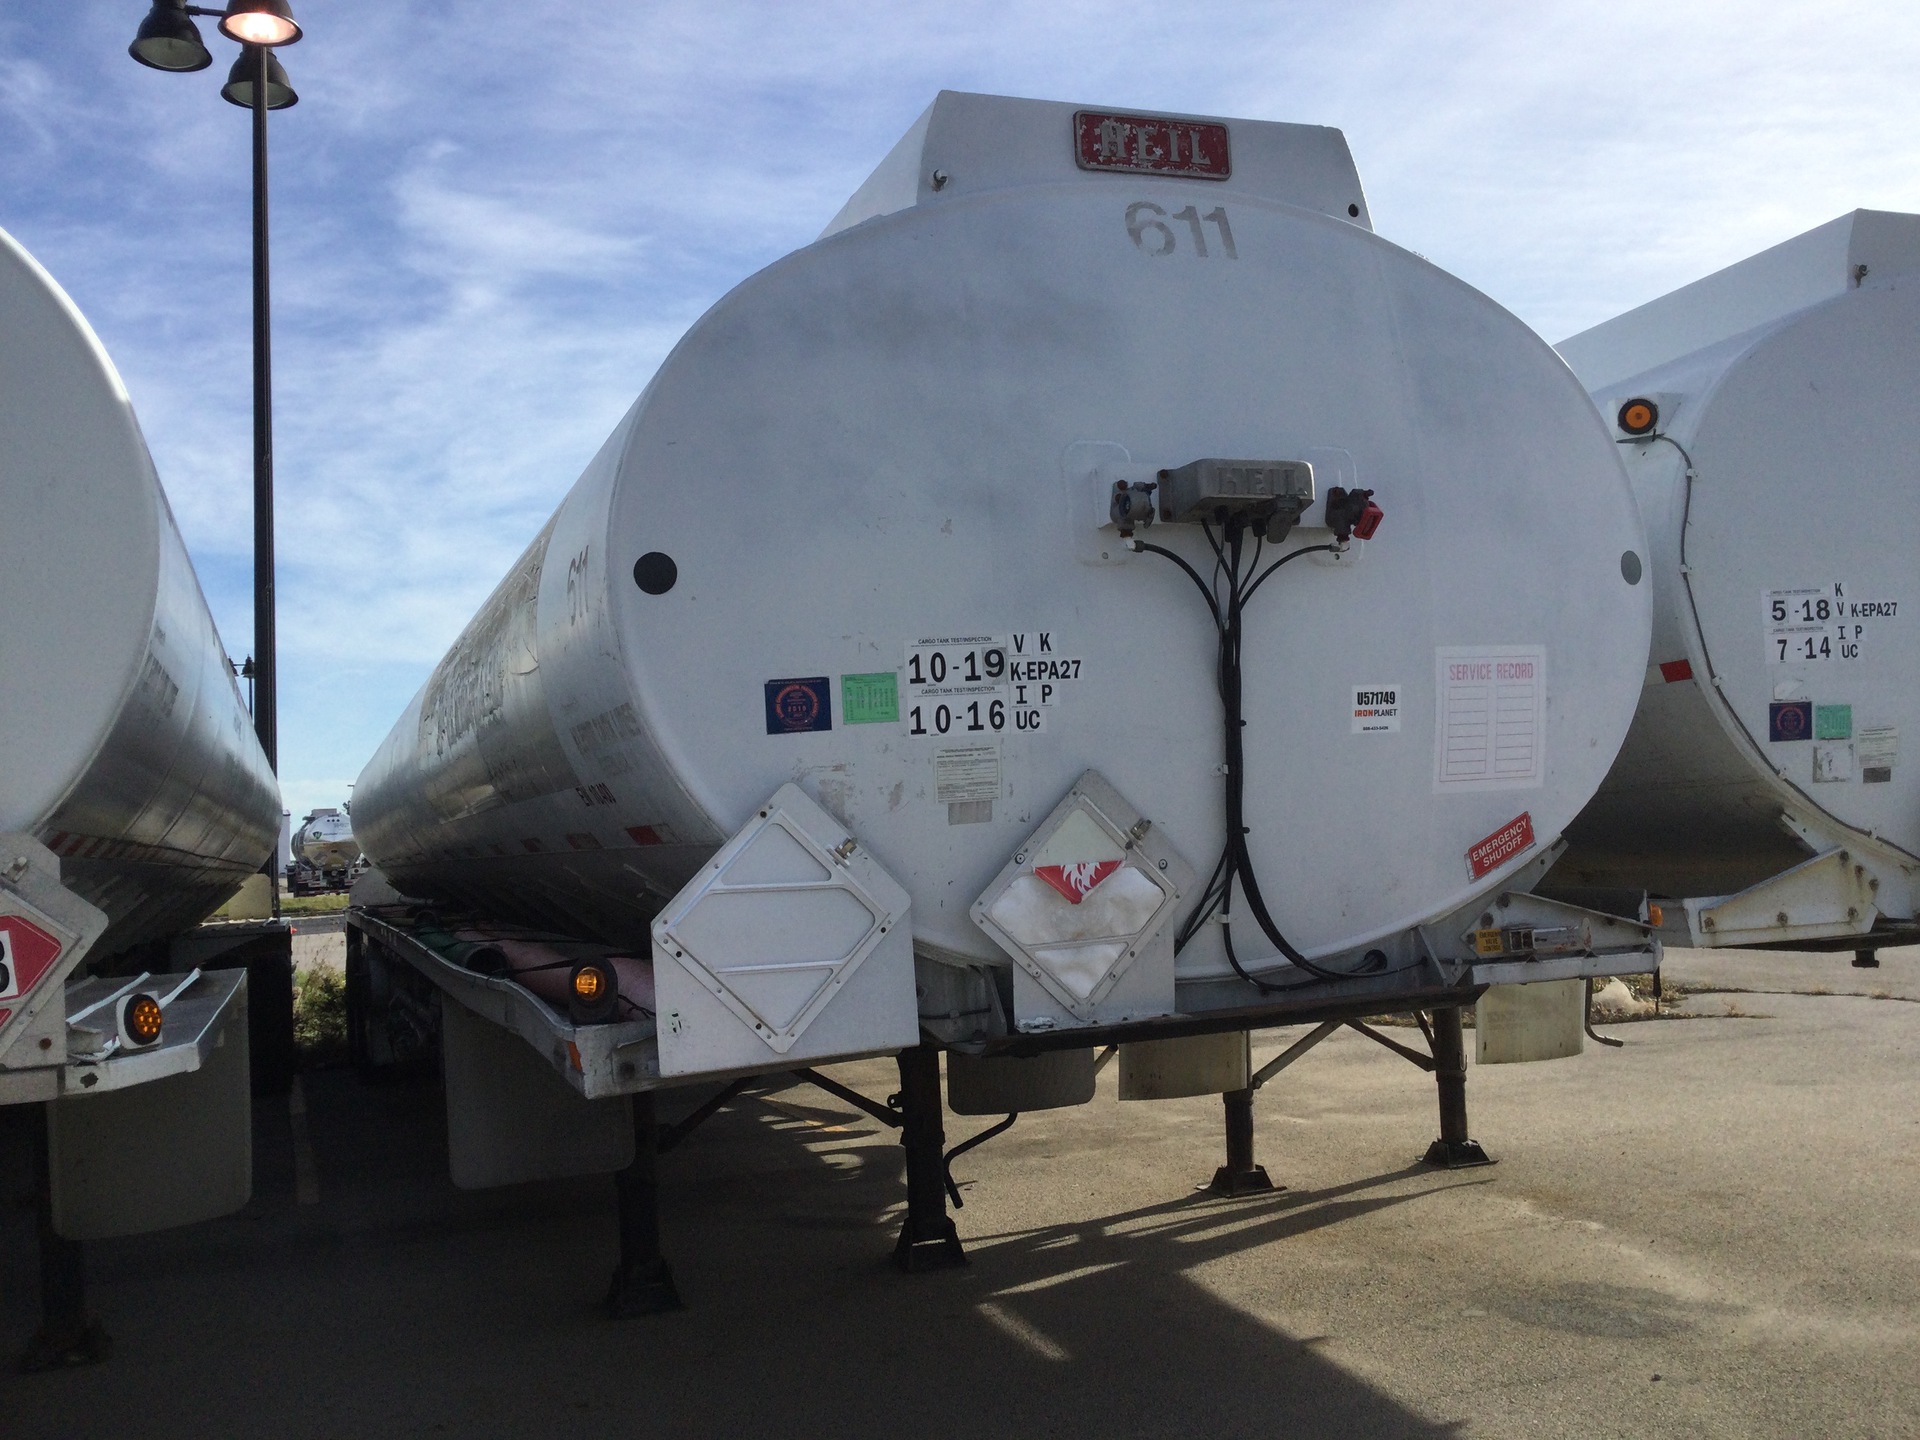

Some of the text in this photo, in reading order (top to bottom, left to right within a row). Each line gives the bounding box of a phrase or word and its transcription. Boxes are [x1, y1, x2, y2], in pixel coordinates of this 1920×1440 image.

[1099, 121, 1211, 165] HEIL
[1125, 201, 1239, 260] 611
[1834, 583, 1844, 597] K
[1836, 601, 1845, 616] V
[1850, 602, 1898, 618] K-EPA27
[1013, 632, 1052, 654] V K
[1855, 625, 1863, 640] P
[1841, 644, 1859, 659] UC
[908, 648, 1005, 685] 10-19
[1010, 660, 1082, 682] K-EPA27
[1449, 662, 1534, 681] SERVICE RECORD
[1015, 684, 1053, 705] I P
[1357, 691, 1396, 706] U571749
[909, 699, 1005, 736] 10-16
[1016, 709, 1041, 730] UC
[1472, 818, 1527, 862] EMERGENCY
[1483, 834, 1523, 867] SHUTOFF
